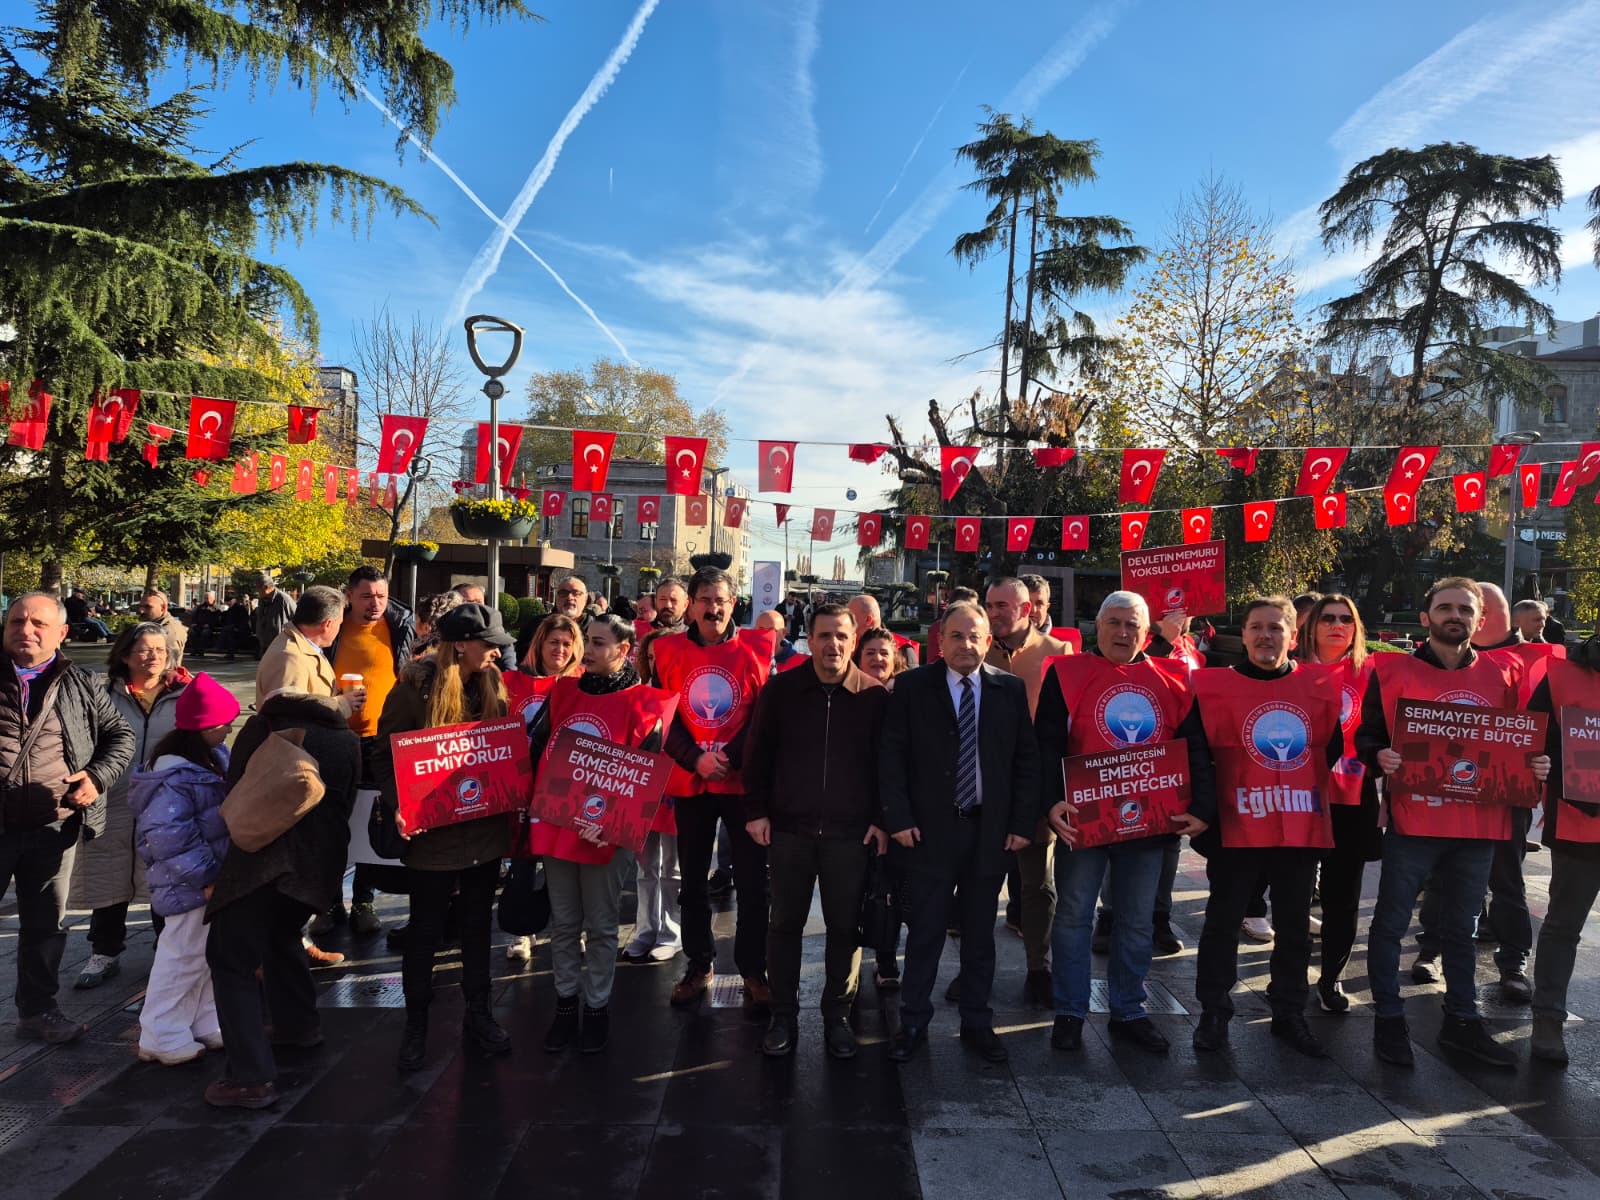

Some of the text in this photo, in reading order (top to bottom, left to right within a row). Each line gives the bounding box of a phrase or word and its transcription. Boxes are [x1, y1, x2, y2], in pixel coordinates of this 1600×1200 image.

[1127, 547, 1218, 567] DEVLETİN MEMURU
[1130, 559, 1215, 578] YOKSUL OLAMAZ!
[1405, 706, 1538, 731] SERMAYEYE DEĞİL
[444, 727, 480, 739] ENFLASYON
[1407, 722, 1532, 747] EMEKÇİYE BÜTÇE
[436, 735, 491, 756] KABUL
[576, 737, 655, 768] GERÇEKLERİ AÇIKLA
[1085, 745, 1166, 769] HALKIN BÜTÇESİNİ
[568, 750, 651, 786] EKMEĞİMLE
[1099, 761, 1155, 782] EMEKÇİ
[572, 767, 635, 798] OYNAMA
[1073, 773, 1183, 804] BELİRLEYECEK!
